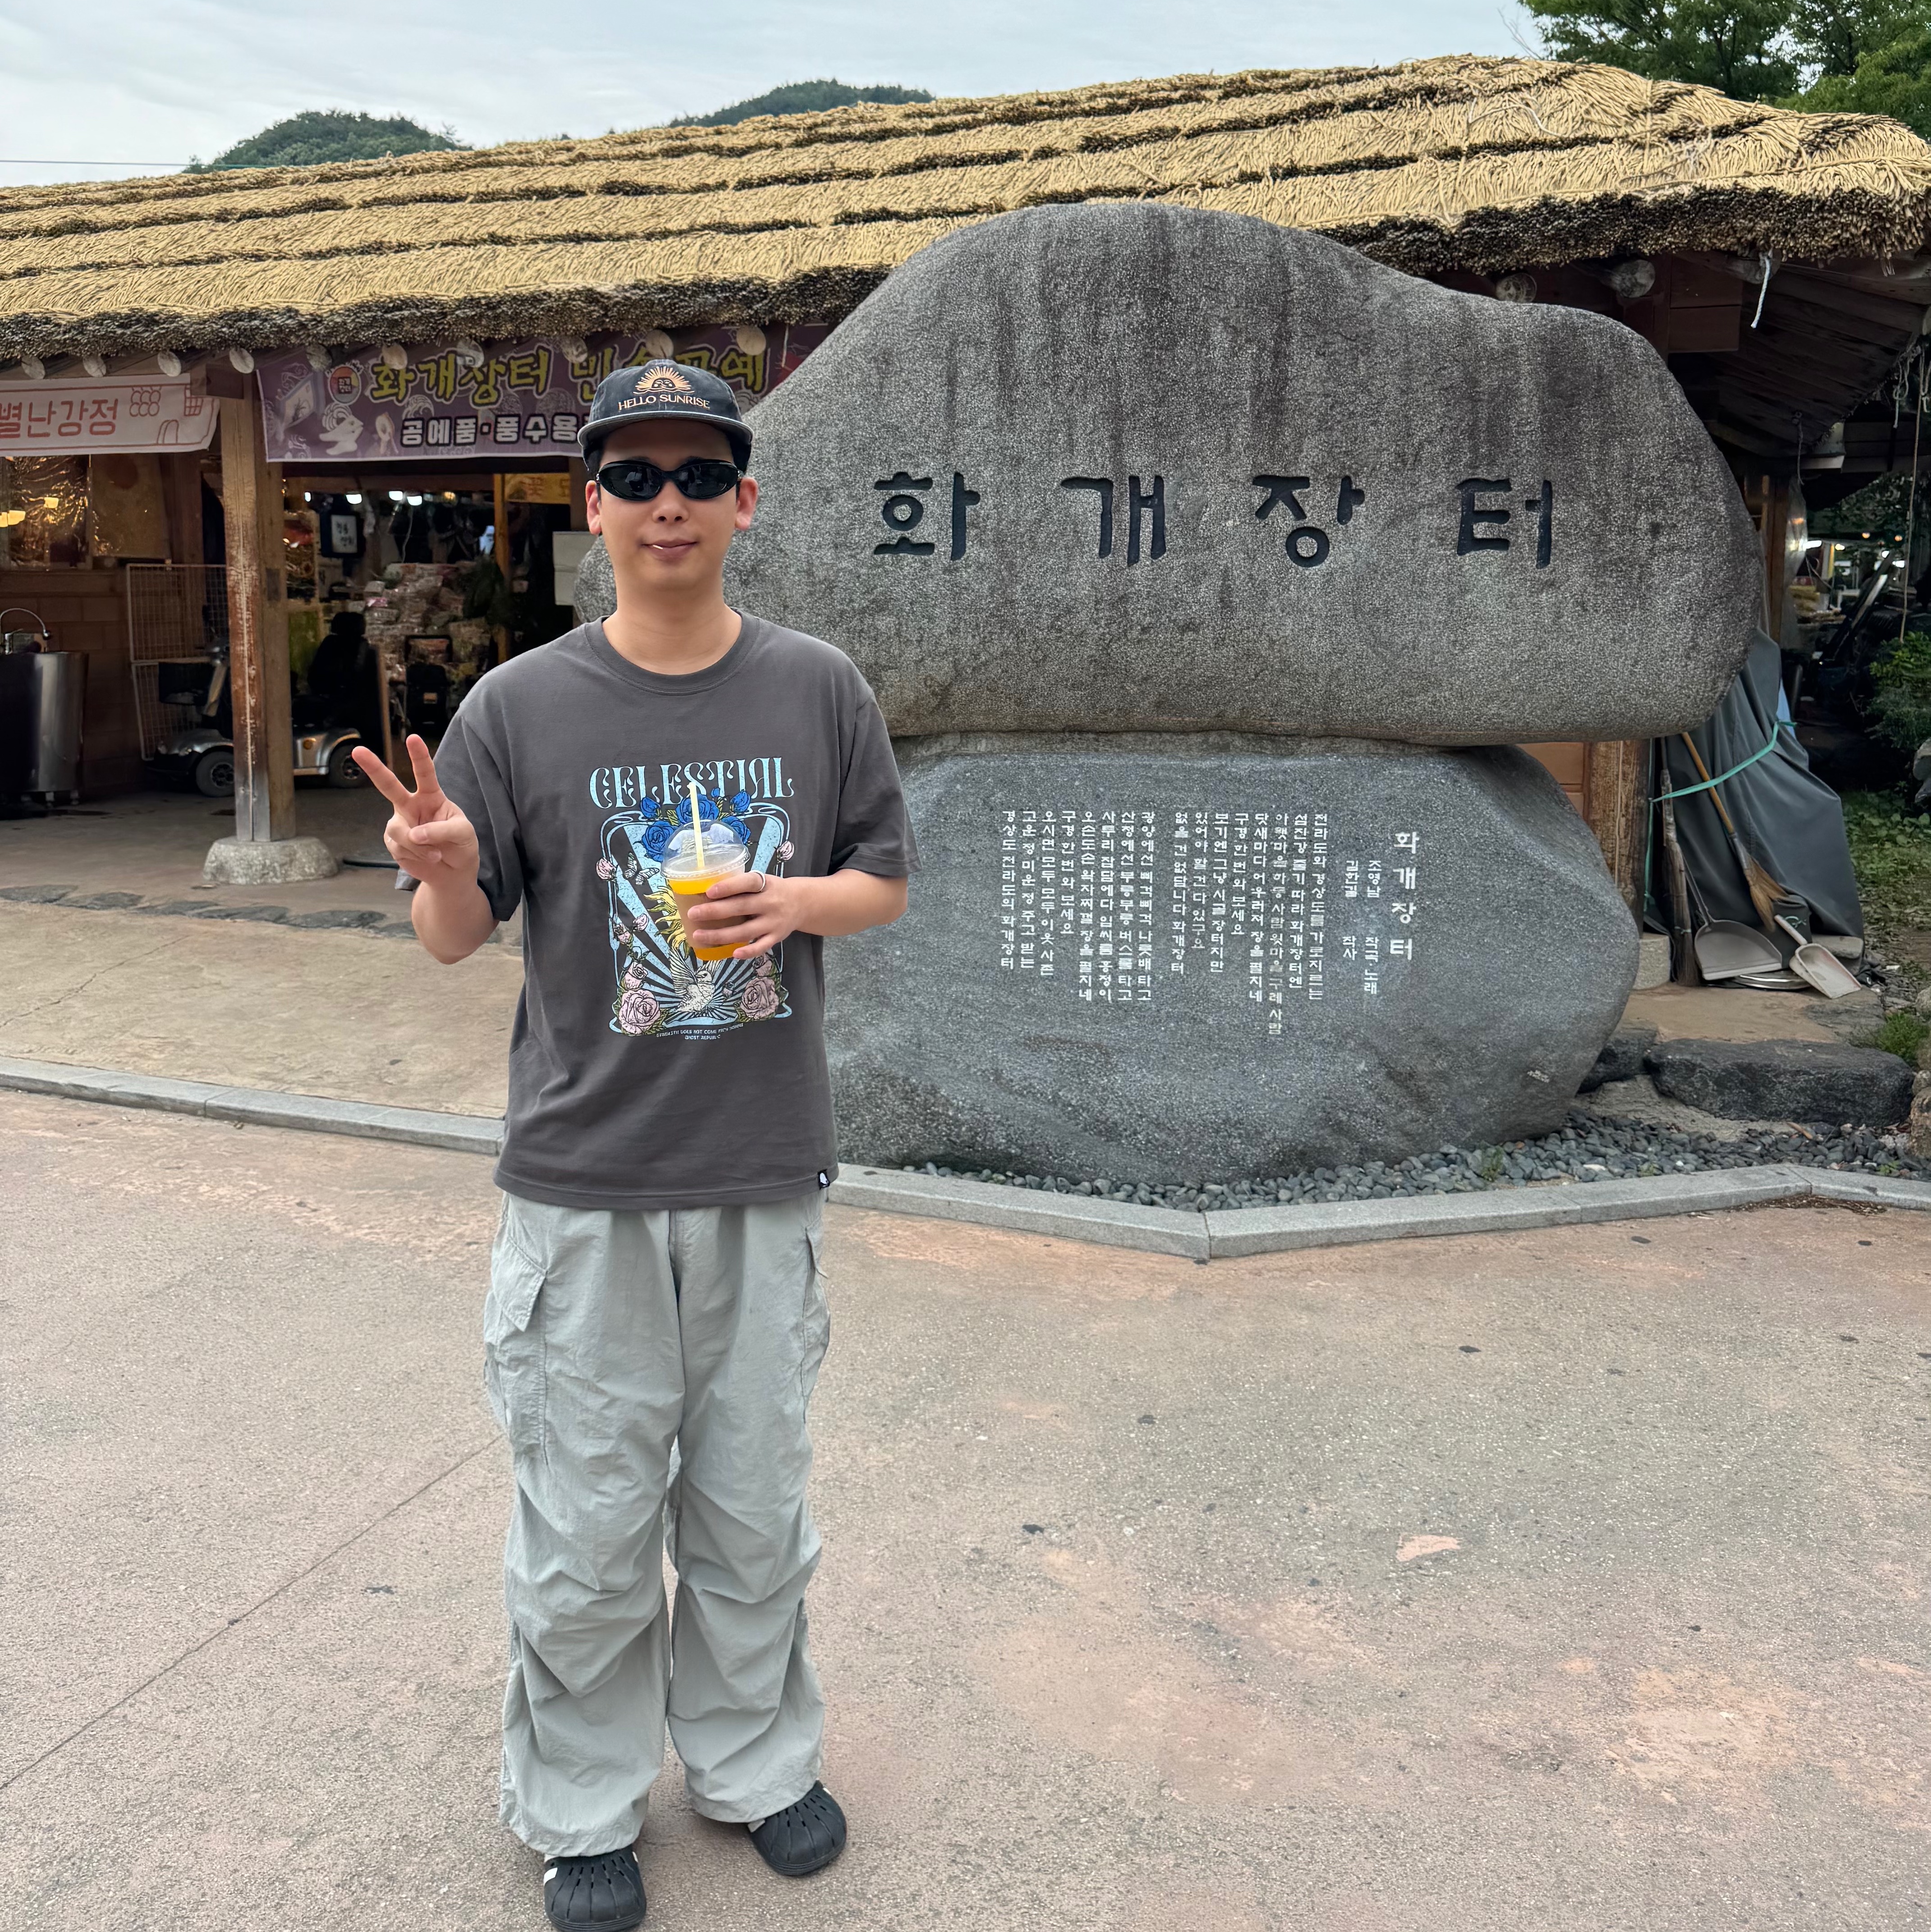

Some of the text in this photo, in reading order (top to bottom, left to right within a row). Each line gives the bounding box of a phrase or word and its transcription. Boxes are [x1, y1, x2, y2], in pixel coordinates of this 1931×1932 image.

[370, 349, 551, 405] 화개장터
[0, 398, 119, 438] 별난강정
[618, 394, 711, 410] HELLO SUNRISE
[874, 472, 1553, 569] 화개장터
[589, 757, 794, 809] CELESTIAL
[1022, 811, 1037, 836] 고운
[1041, 811, 1056, 851] 오시면
[1061, 811, 1076, 837] 구경
[1081, 811, 1096, 865] 오손도손
[1101, 811, 1116, 852] 사투리
[1141, 811, 1156, 866] 광양에선
[1174, 812, 1189, 838] 없을
[1195, 812, 1208, 853] 있어야
[1234, 813, 1249, 839] 구경
[1253, 813, 1269, 867] 닷새마다
[1000, 810, 1017, 969] 경상도 전라도의 화개장터
[1021, 860, 1036, 886] 미운
[1041, 857, 1056, 882] 모두
[1100, 856, 1115, 911] 잡담에다
[1173, 862, 1188, 916] 없답니다
[1272, 872, 1286, 898] 하동
[1367, 860, 1382, 898] 조영남
[1041, 888, 1055, 914] 모두
[1119, 871, 1134, 925] 부릉부릉
[1139, 871, 1153, 926] 삐걱삐걱
[1210, 813, 1229, 973] 보기엔 그냥 시골 장터지만
[1251, 872, 1266, 926] 어우러져
[1289, 813, 1308, 988] 섬진강 줄기 따라 화개장터엔
[1308, 813, 1328, 1000] 전라도와 경상도를 가로지르는
[1342, 860, 1360, 961] 김한길 작사
[1390, 831, 1420, 960] 화개장터
[1099, 916, 1113, 955] 입씨름
[1191, 909, 1206, 949] 있구요
[1271, 903, 1285, 928] 사람
[1079, 930, 1094, 956] 장을
[1118, 930, 1133, 970] 버스를
[1171, 921, 1186, 974] 화개장터
[1250, 931, 1264, 957] 장을
[1117, 975, 1132, 1000] 타고
[1137, 975, 1152, 1000] 타고
[1269, 1009, 1283, 1034] 사람
